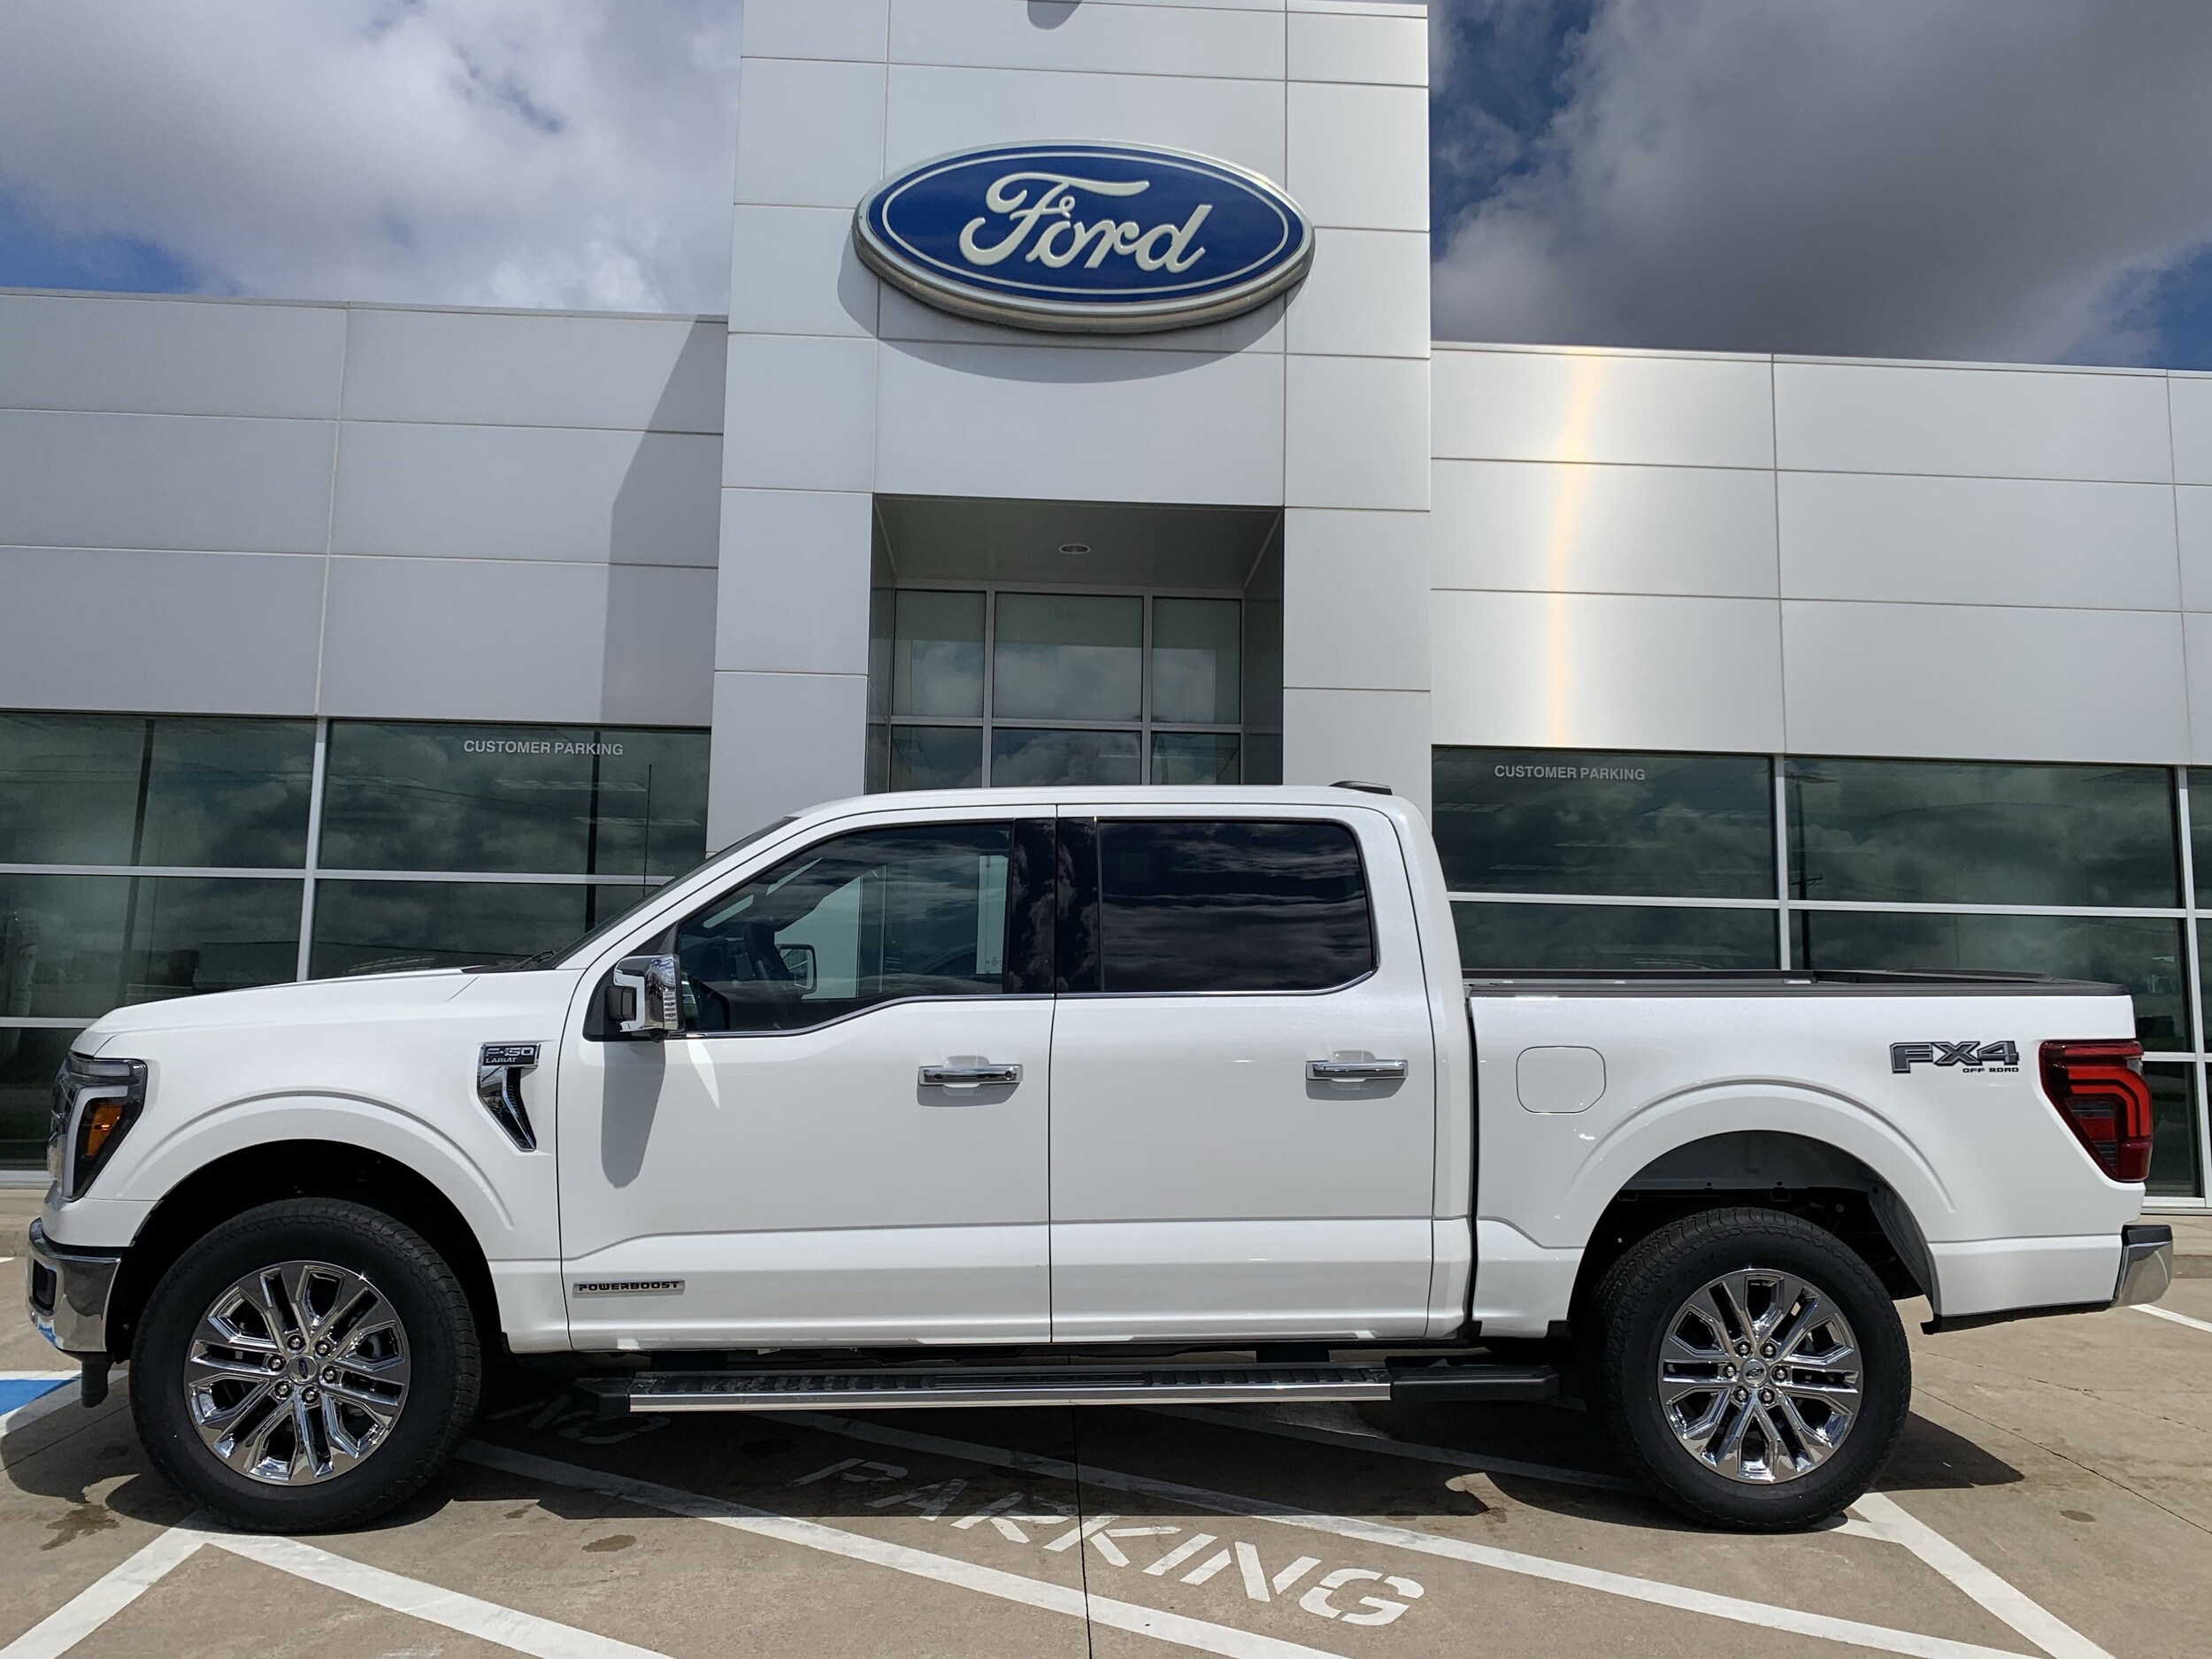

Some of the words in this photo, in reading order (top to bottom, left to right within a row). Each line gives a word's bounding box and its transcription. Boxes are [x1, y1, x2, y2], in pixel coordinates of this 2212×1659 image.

[959, 172, 1213, 273] Ford
[464, 740, 550, 754] CUSTOMER
[554, 741, 624, 756] PARKING
[1494, 764, 1577, 779] CUSTOMER
[1580, 767, 1646, 780] PARKING
[485, 1047, 534, 1057] F-150
[1889, 1041, 2019, 1073] FX4
[579, 1280, 680, 1292] POWERBOOST
[788, 1457, 1425, 1626] PARKING
